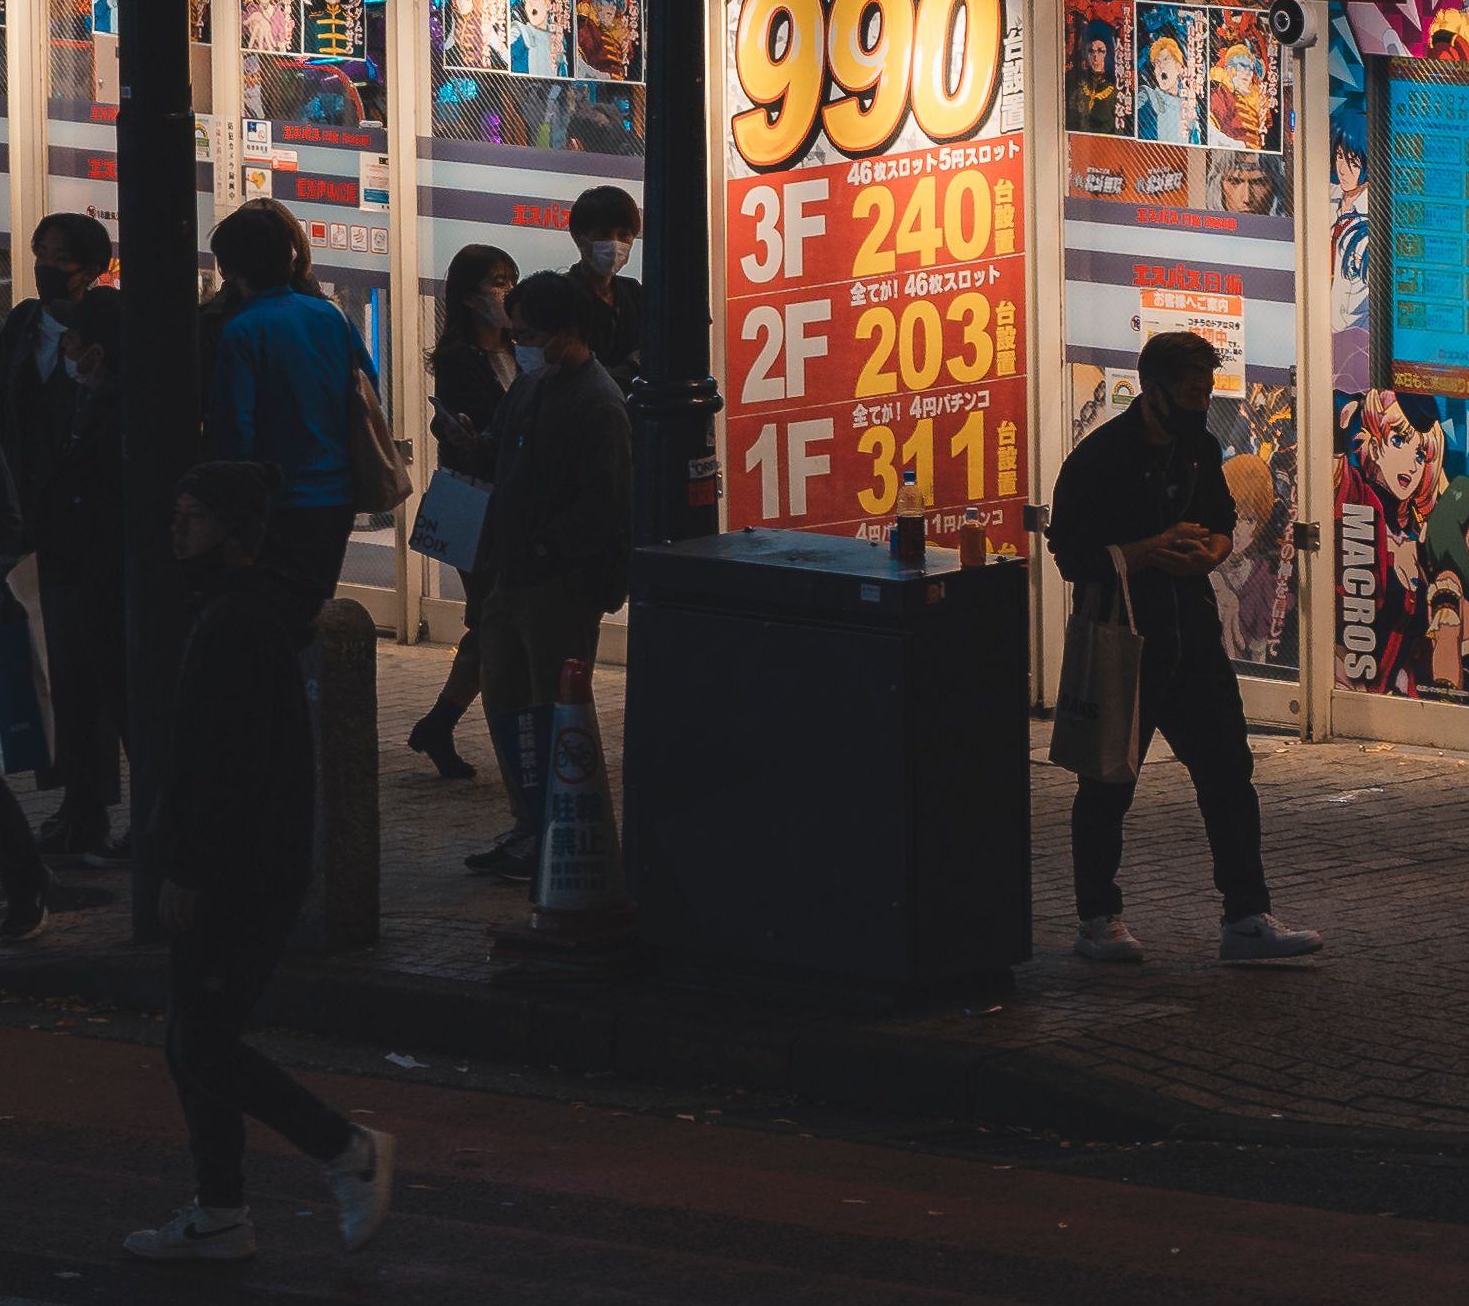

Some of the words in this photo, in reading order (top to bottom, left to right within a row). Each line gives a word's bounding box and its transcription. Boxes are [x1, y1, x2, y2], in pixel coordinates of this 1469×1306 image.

[1000, 25, 1025, 135] 台設置
[296, 177, 359, 204] ESPACE
[740, 179, 830, 285] 3F
[852, 168, 993, 278] 240
[993, 178, 1016, 256] 台設置
[741, 299, 832, 404] 2F
[854, 292, 995, 399] 203
[995, 300, 1017, 377] 台設置
[909, 390, 991, 420] 4円パチンコ
[745, 417, 835, 520] 1F
[856, 411, 986, 516] 311
[997, 421, 1019, 497] 台設置
[1340, 501, 1378, 683] MACROS
